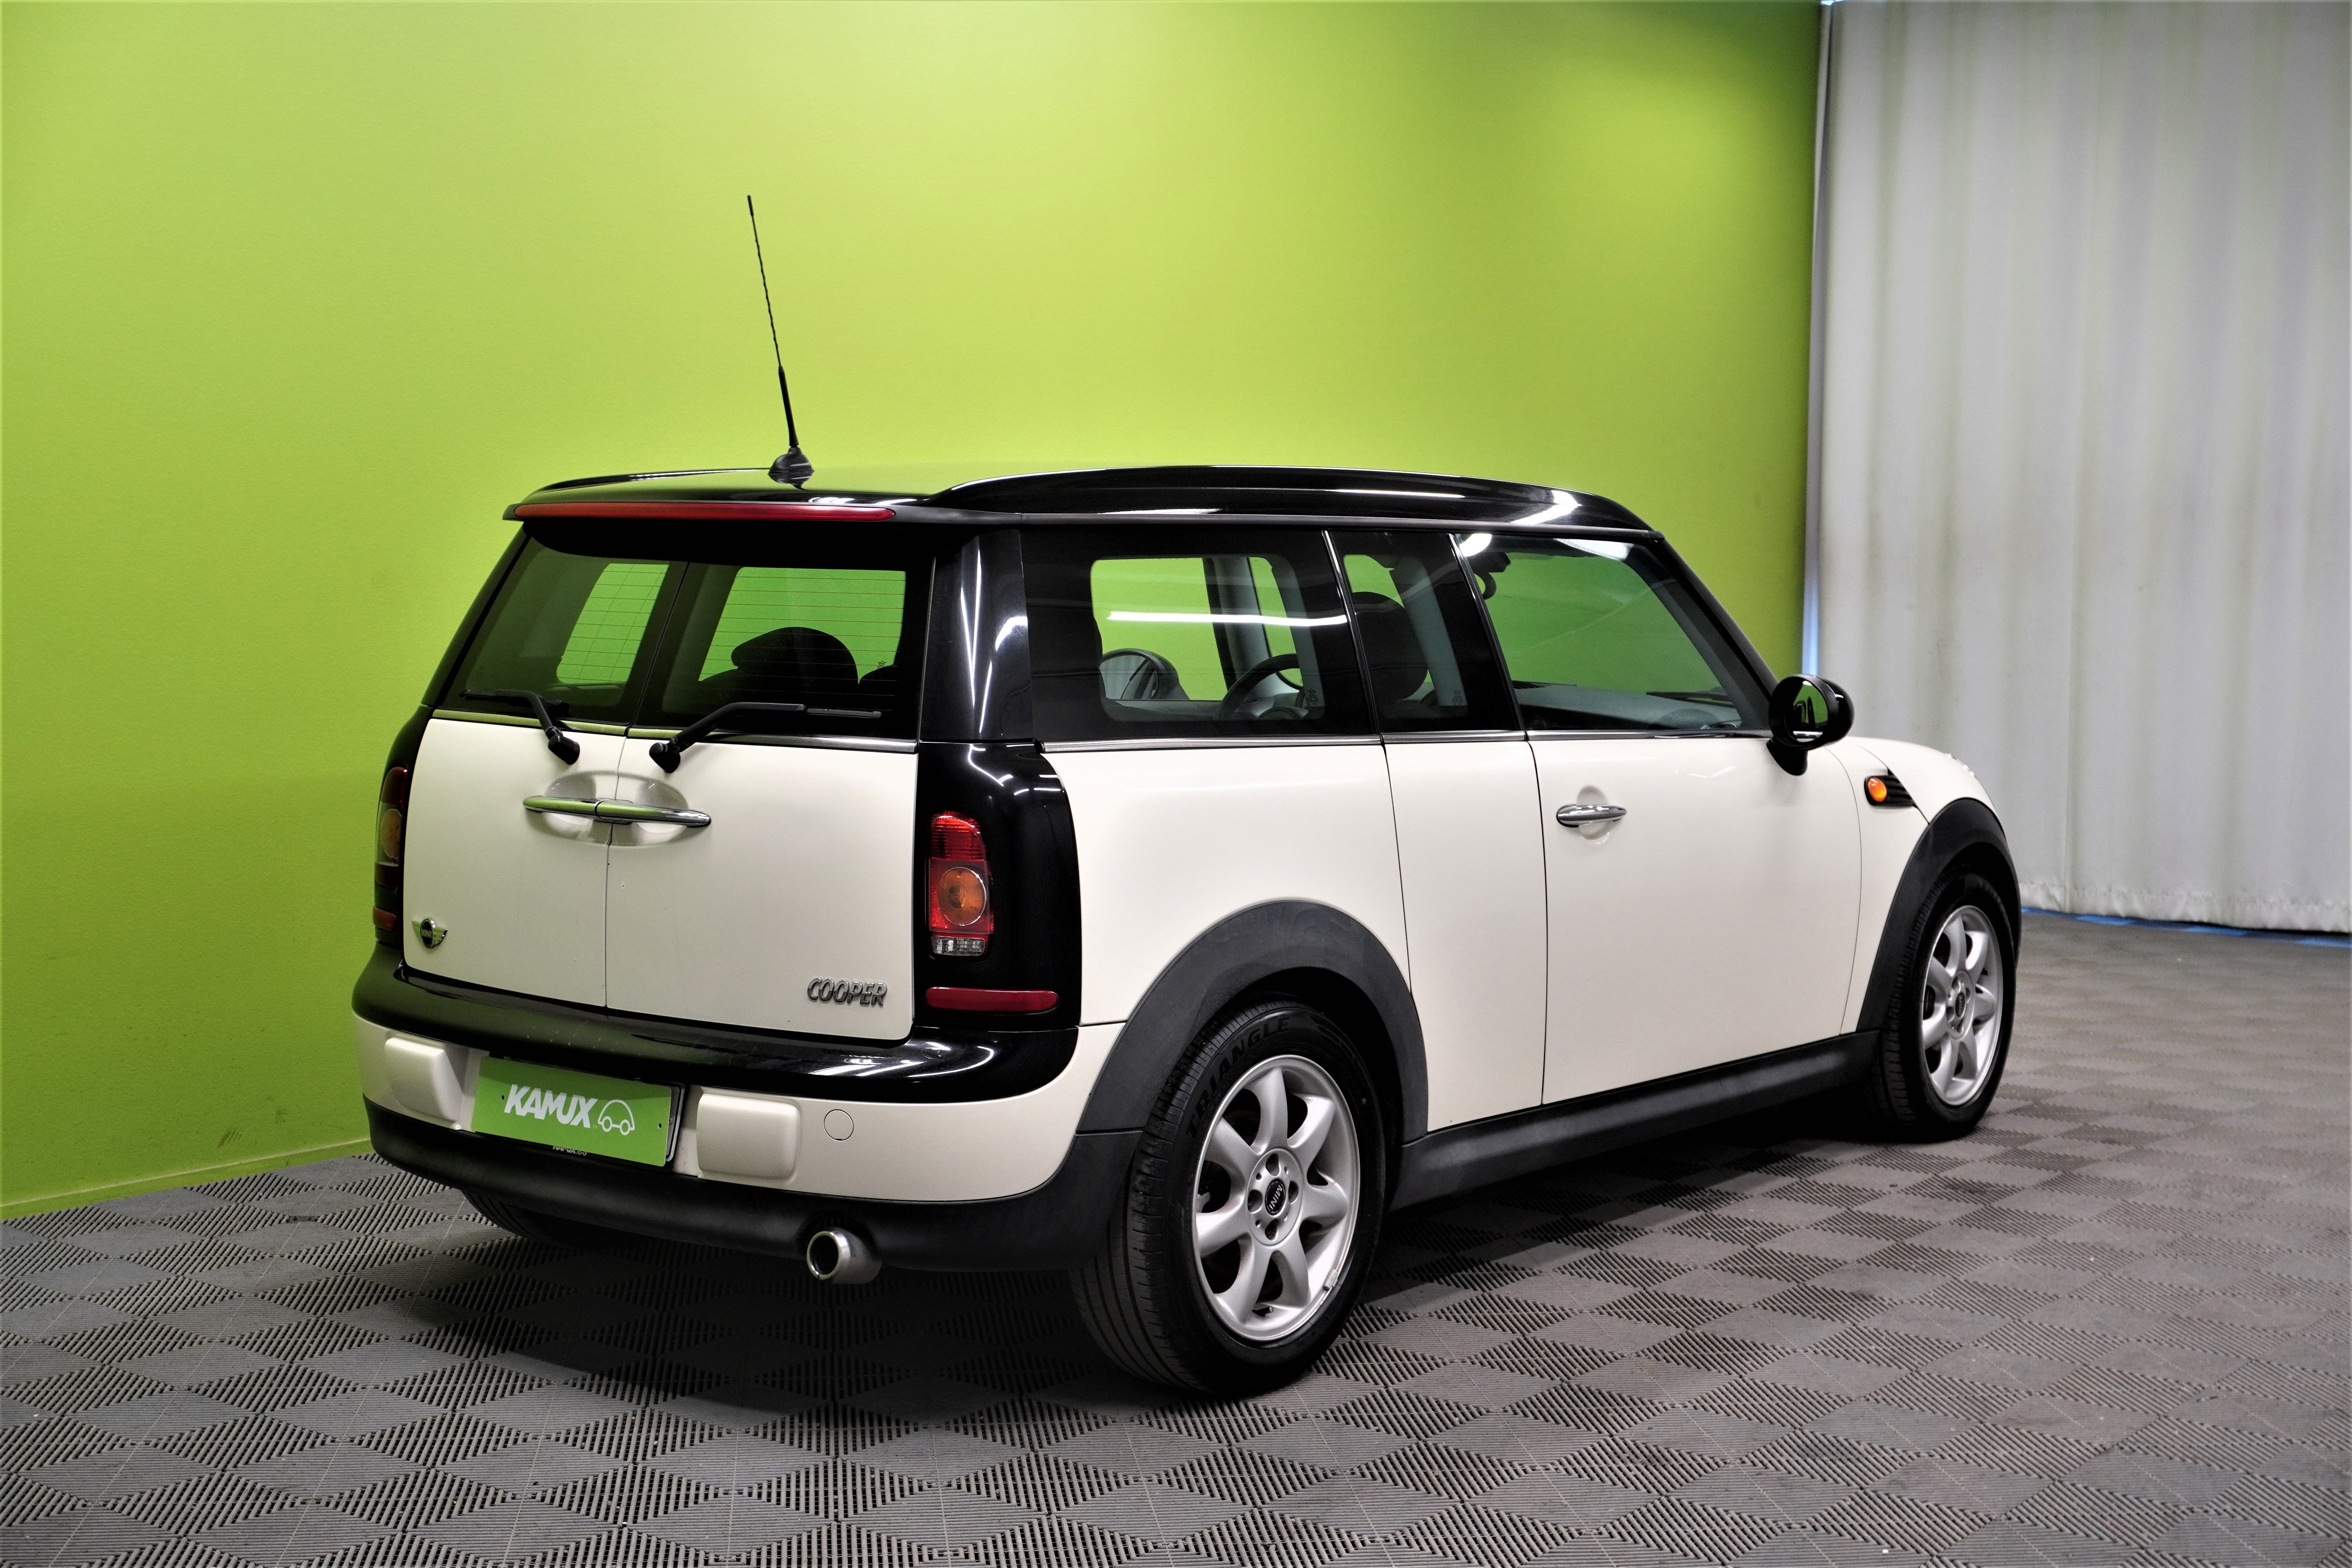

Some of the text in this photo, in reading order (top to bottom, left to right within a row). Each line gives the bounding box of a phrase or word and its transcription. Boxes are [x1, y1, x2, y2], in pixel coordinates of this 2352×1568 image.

[421, 929, 432, 938] MINI
[807, 978, 887, 1005] COOPER
[1187, 1016, 1290, 1139] TRIANGLE
[504, 1084, 599, 1128] KAMUX
[1269, 1184, 1283, 1210] MINI
